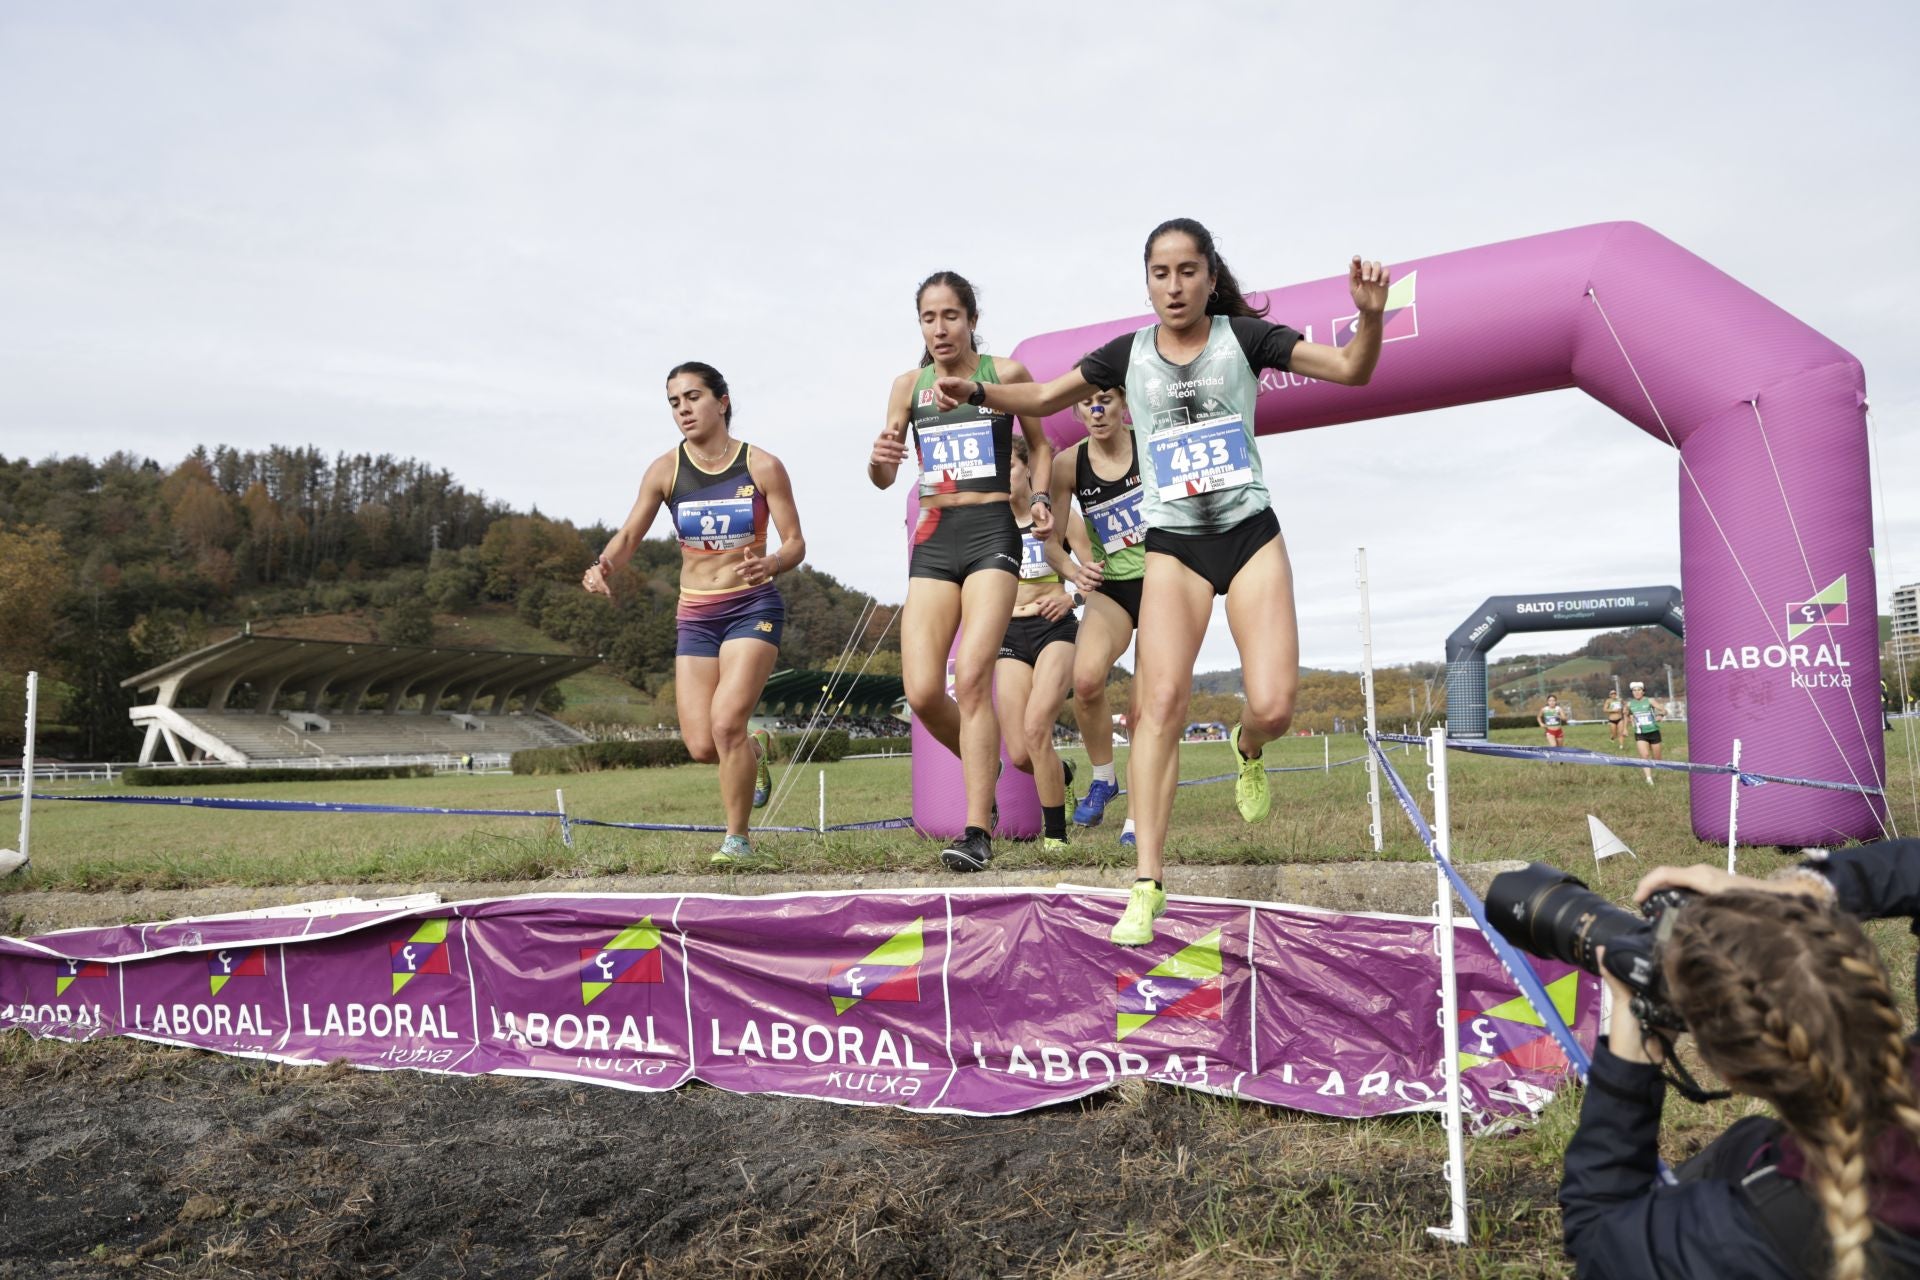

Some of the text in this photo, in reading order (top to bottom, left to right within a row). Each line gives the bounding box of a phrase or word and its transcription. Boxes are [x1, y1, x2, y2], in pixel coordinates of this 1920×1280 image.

[1166, 376, 1224, 391] universidad
[1175, 388, 1195, 399] león
[933, 437, 980, 463] 418
[1170, 438, 1230, 473] 433
[1172, 463, 1235, 485] MIREN MARTIN
[700, 514, 731, 535] 27
[1022, 545, 1042, 563] 21
[1516, 602, 1555, 614] SALTO
[1557, 596, 1635, 611] FOUNDATION
[1705, 643, 1850, 671] LABORAL
[1791, 671, 1852, 688] kutxa
[135, 1004, 273, 1036] LABORAL
[303, 1003, 459, 1039] LABORAL
[490, 1006, 670, 1053] LABORAL
[711, 1018, 930, 1072] LABORAL
[828, 1070, 922, 1097] kutxa
